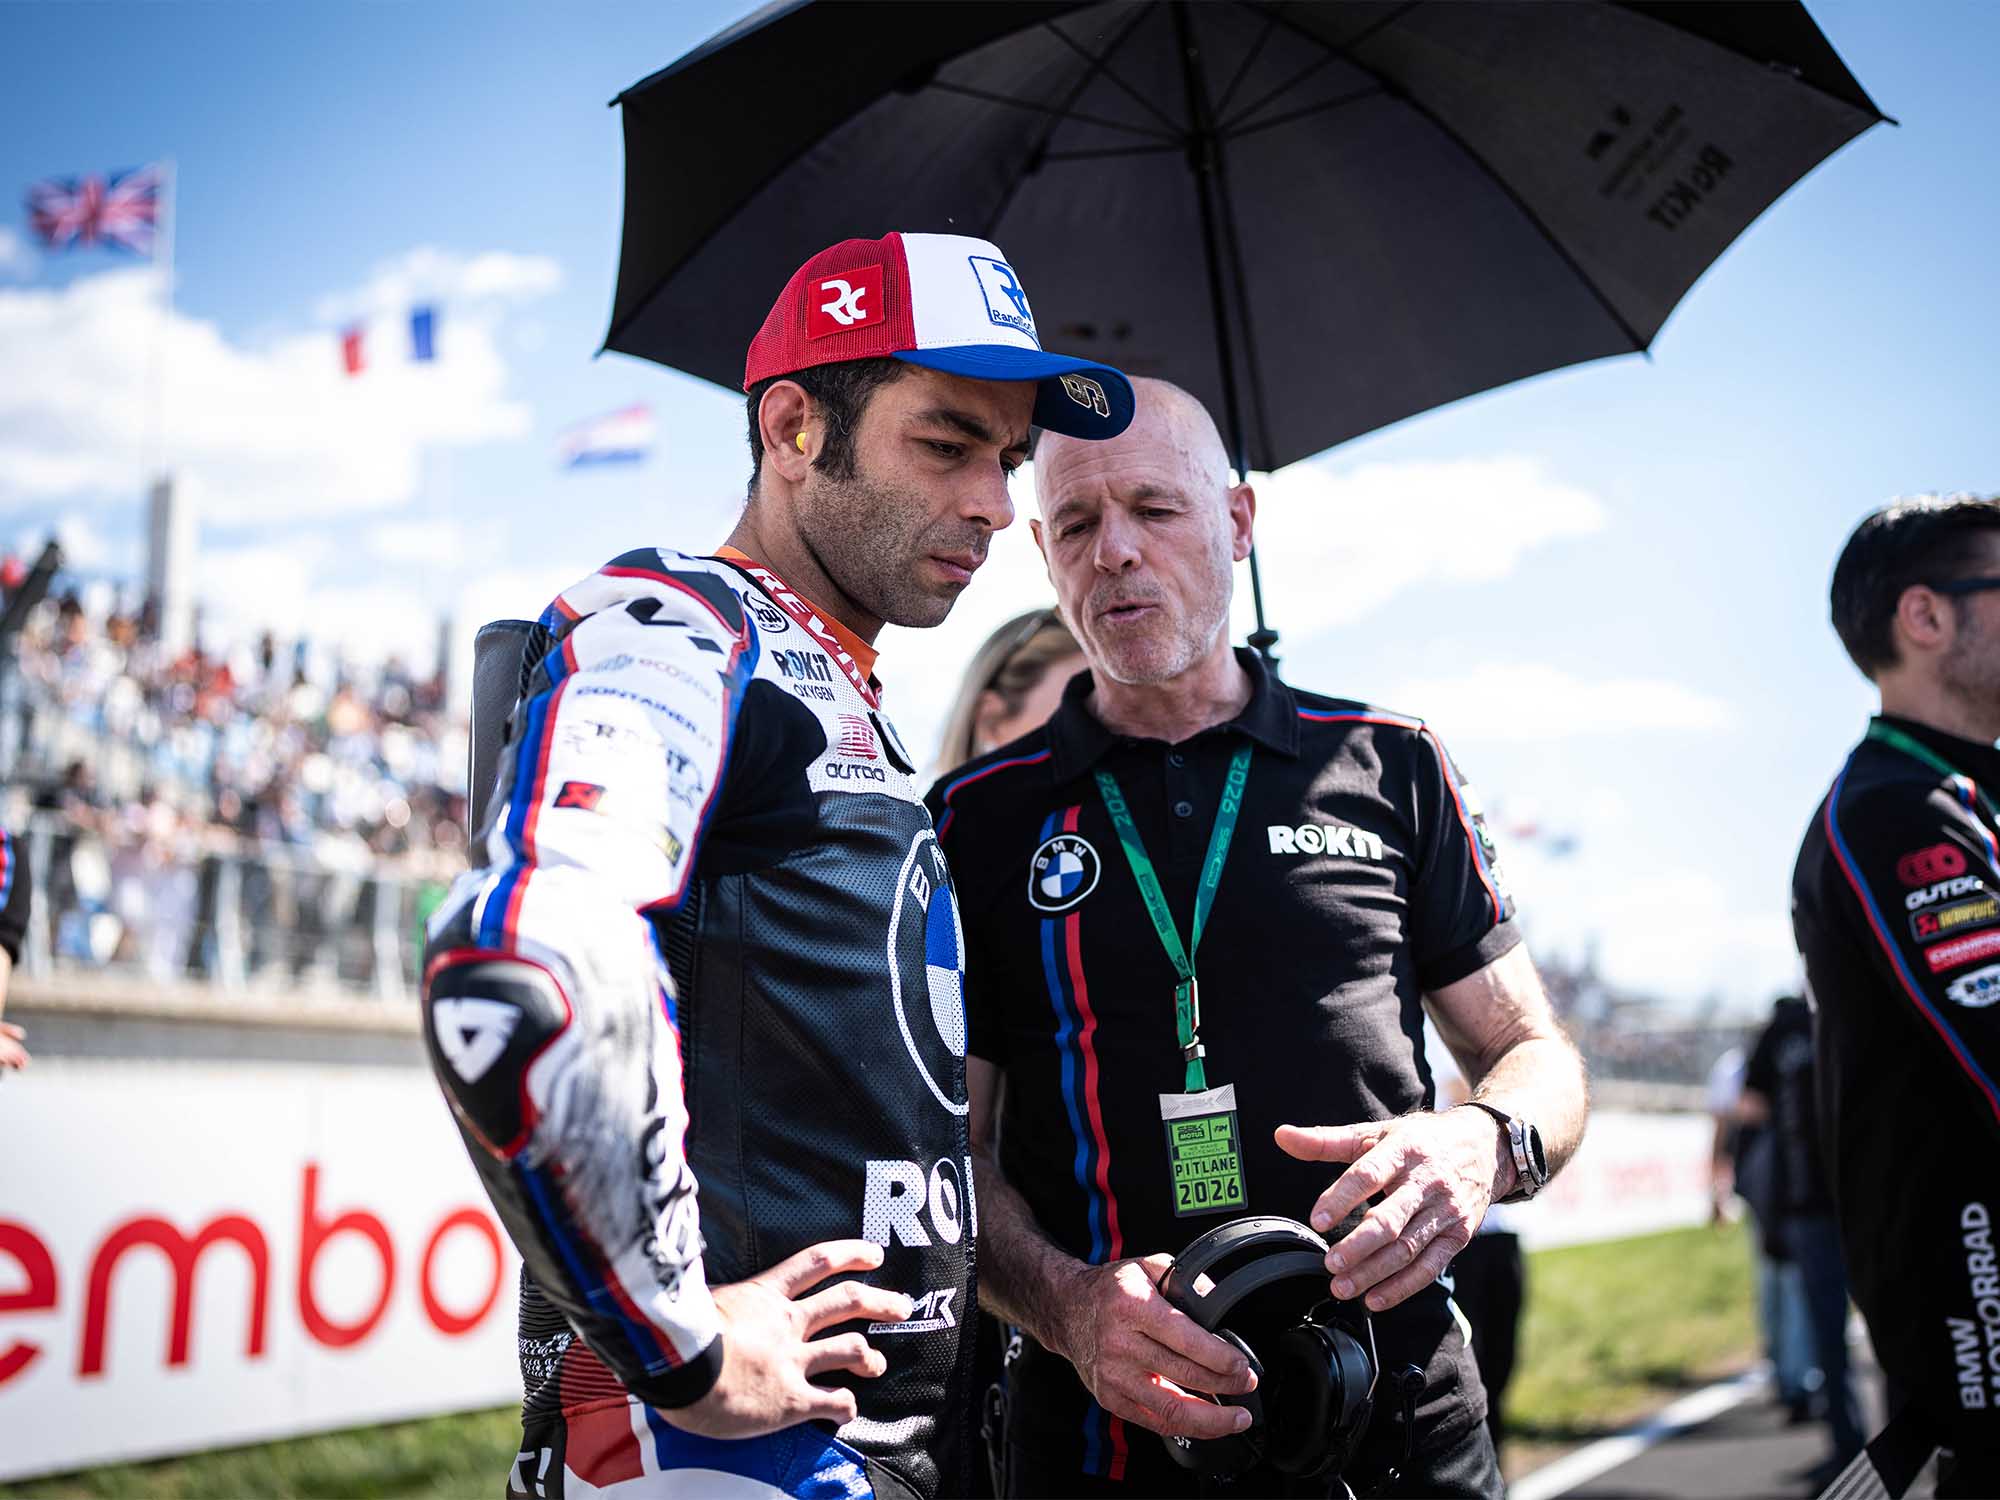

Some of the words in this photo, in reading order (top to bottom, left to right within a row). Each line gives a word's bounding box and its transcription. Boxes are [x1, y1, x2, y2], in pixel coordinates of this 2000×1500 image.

[793, 684, 835, 701] OXYGEN
[1036, 840, 1087, 870] BMW
[1175, 1156, 1237, 1177] PITLANE
[1179, 1177, 1240, 1206] 2026
[1946, 1316, 1987, 1410] BMW
